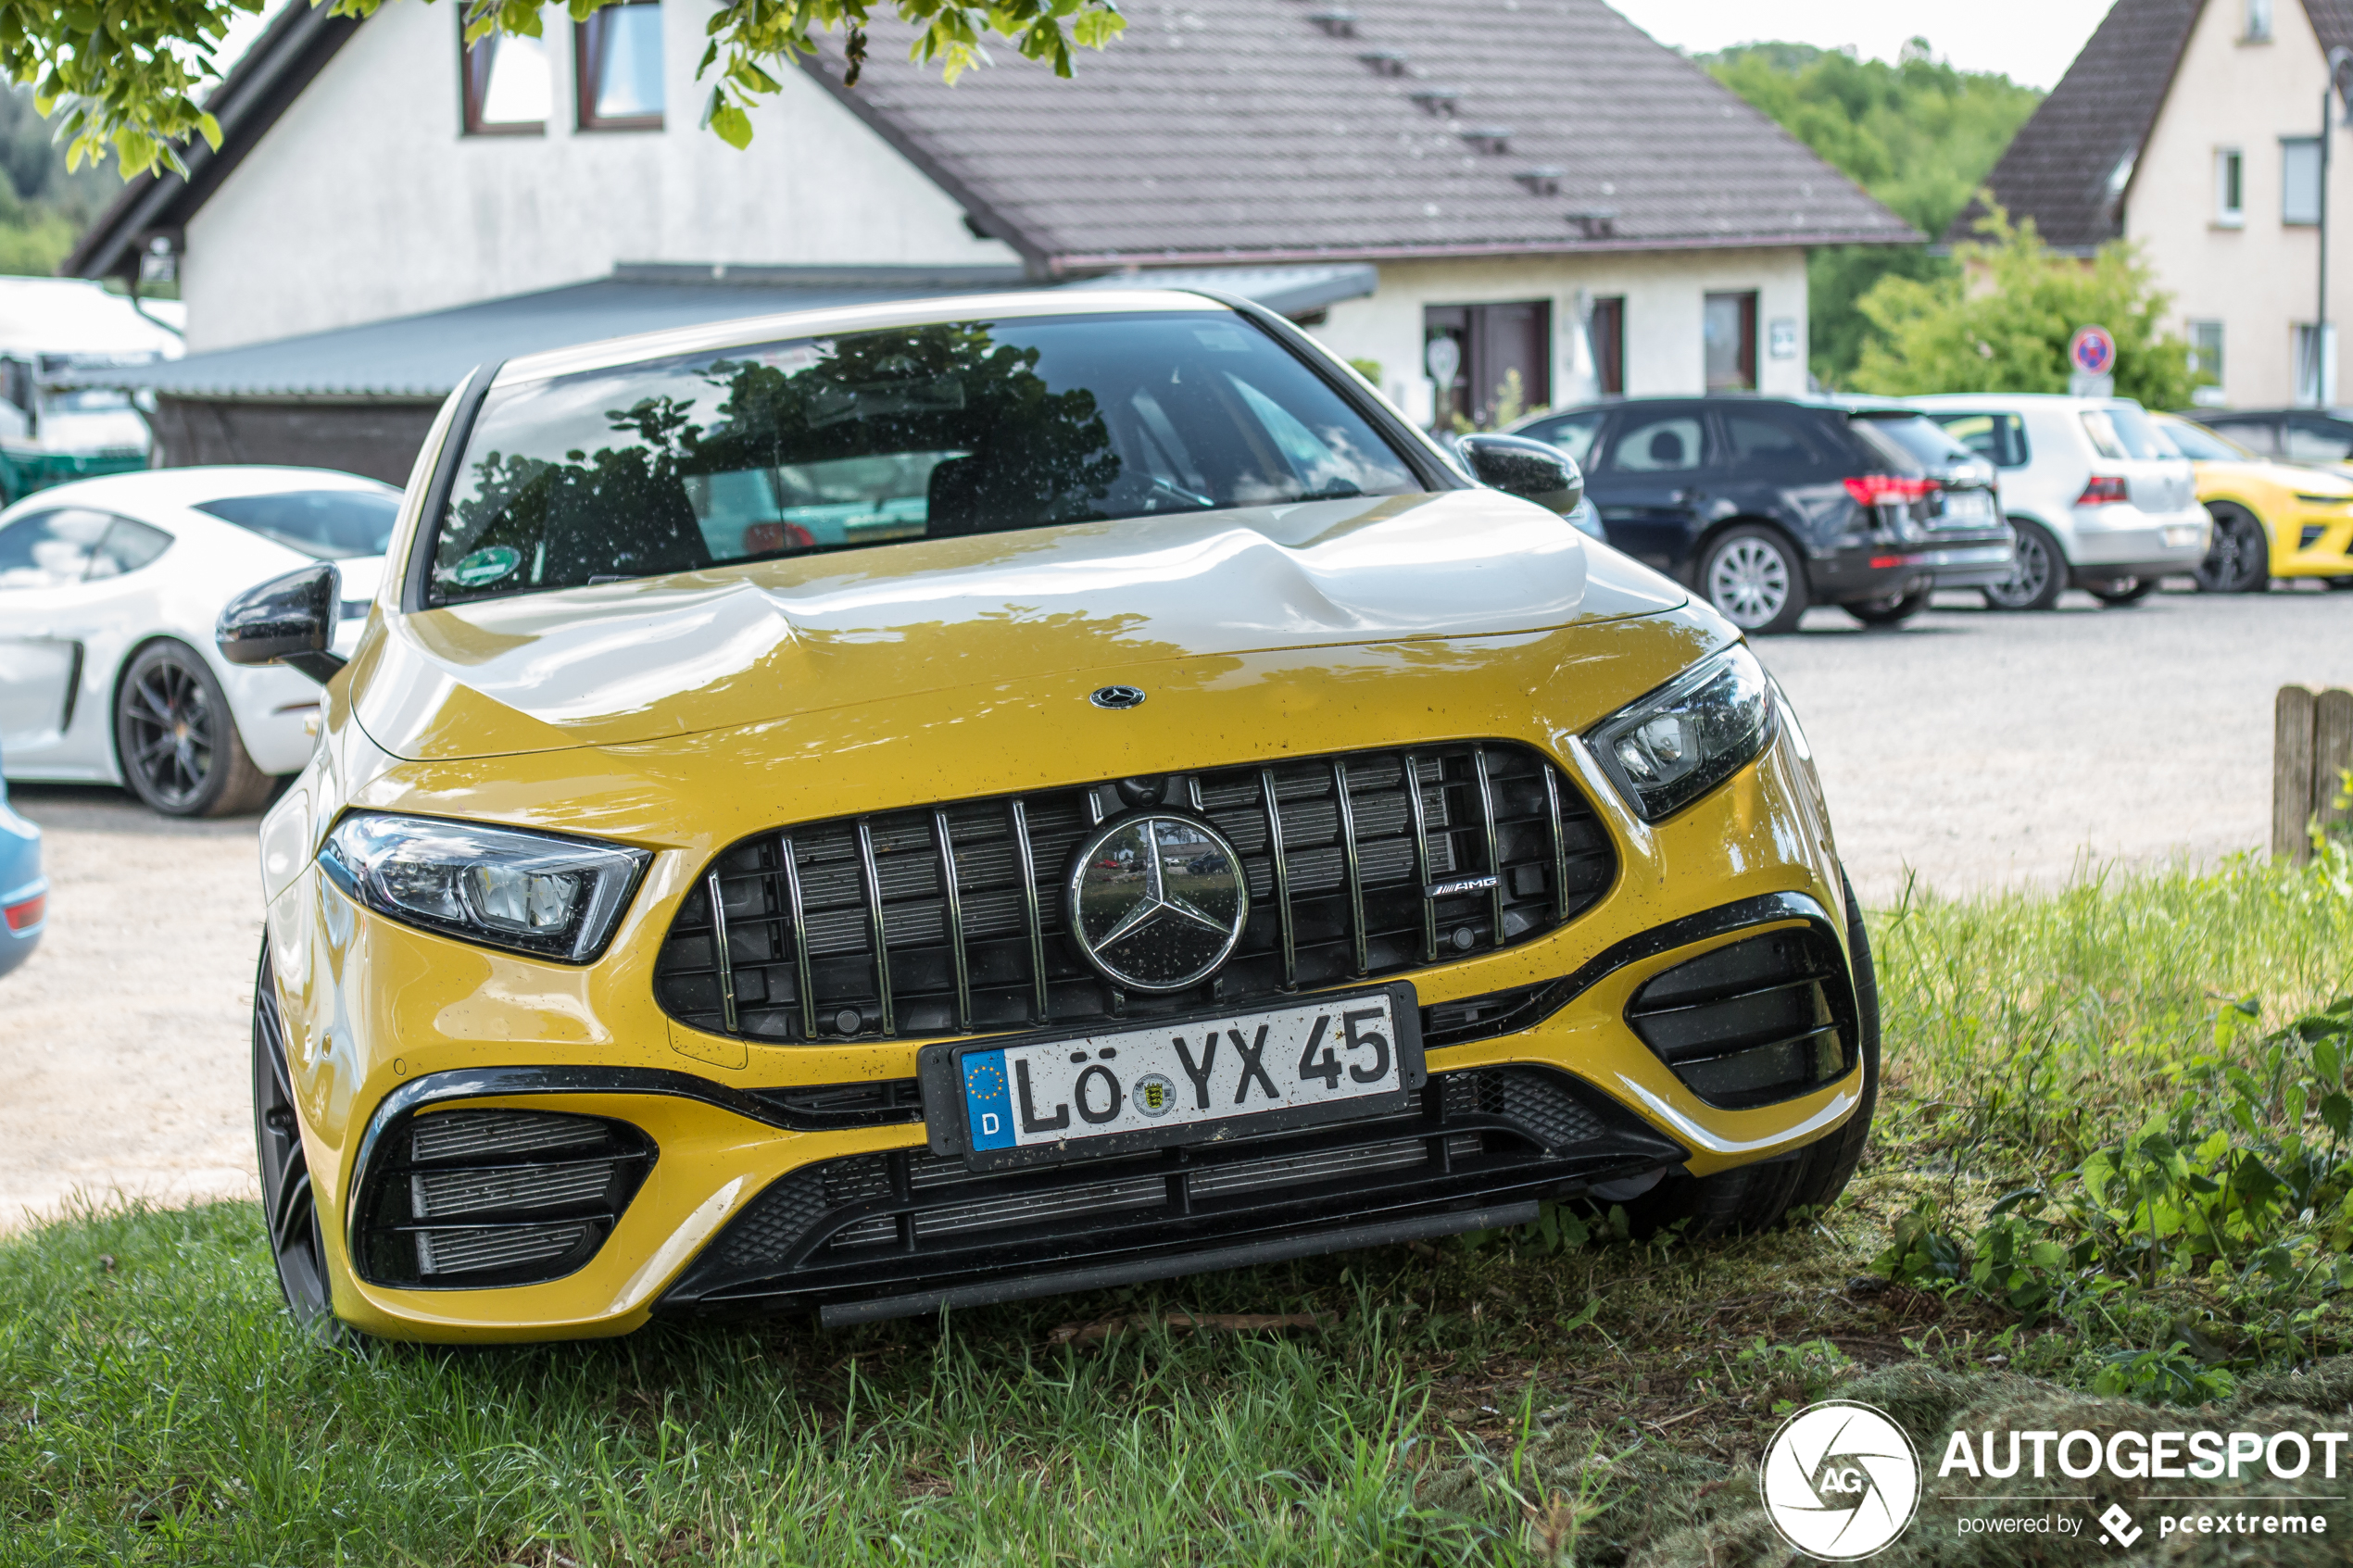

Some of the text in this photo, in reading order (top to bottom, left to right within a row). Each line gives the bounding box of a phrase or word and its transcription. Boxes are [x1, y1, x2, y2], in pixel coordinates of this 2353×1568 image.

[1453, 877, 1497, 892] AMG
[1015, 1006, 1390, 1135] LÖ YX 45
[982, 1112, 1000, 1135] D
